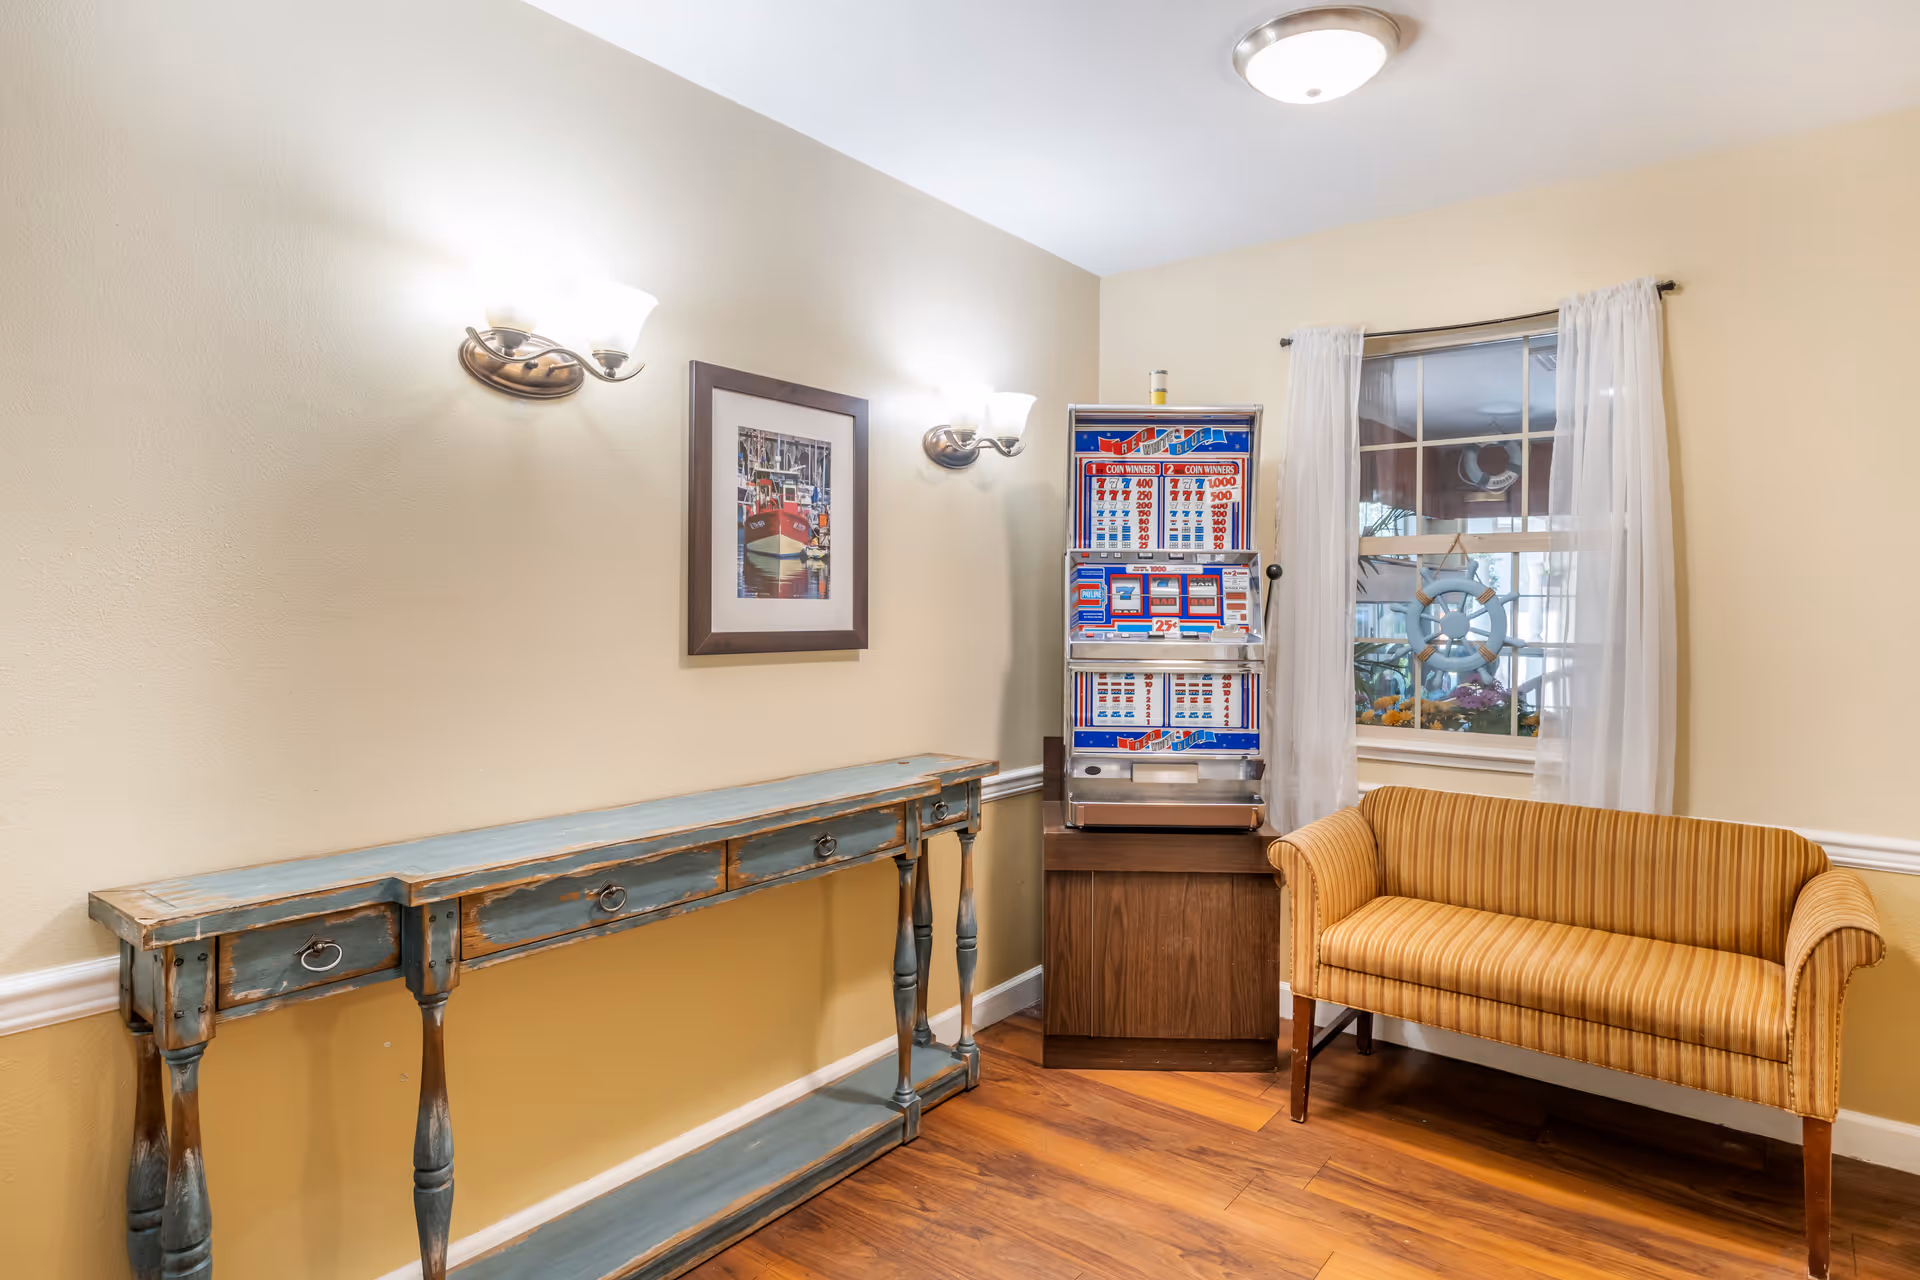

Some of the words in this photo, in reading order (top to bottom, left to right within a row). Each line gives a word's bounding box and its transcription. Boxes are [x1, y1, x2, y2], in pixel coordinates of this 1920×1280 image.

[1122, 431, 1148, 454] RED
[1142, 432, 1174, 455] WHITE
[1176, 430, 1205, 454] BLUE
[1106, 465, 1124, 474] COIN
[1125, 465, 1156, 474] WINNERS
[1185, 465, 1203, 474] COIN
[1204, 465, 1234, 474] WINNERS
[1096, 478, 1106, 488] 7
[1109, 478, 1119, 488] 7
[1122, 478, 1131, 488] 7
[1136, 478, 1153, 488] 400
[1170, 479, 1180, 489] 7
[1182, 479, 1192, 489] 7
[1195, 479, 1205, 489] 7
[1096, 490, 1106, 500] 7
[1109, 490, 1119, 500] 7
[1122, 490, 1131, 500] 7
[1137, 491, 1152, 501] 250
[1170, 491, 1180, 501] 7
[1182, 491, 1192, 501] 7
[1195, 491, 1205, 501] 7
[1210, 491, 1232, 502] 500
[1116, 586, 1136, 600] 7
[1135, 732, 1155, 750] RED
[1151, 732, 1175, 751] WHITE
[1177, 732, 1200, 750] BLUE
